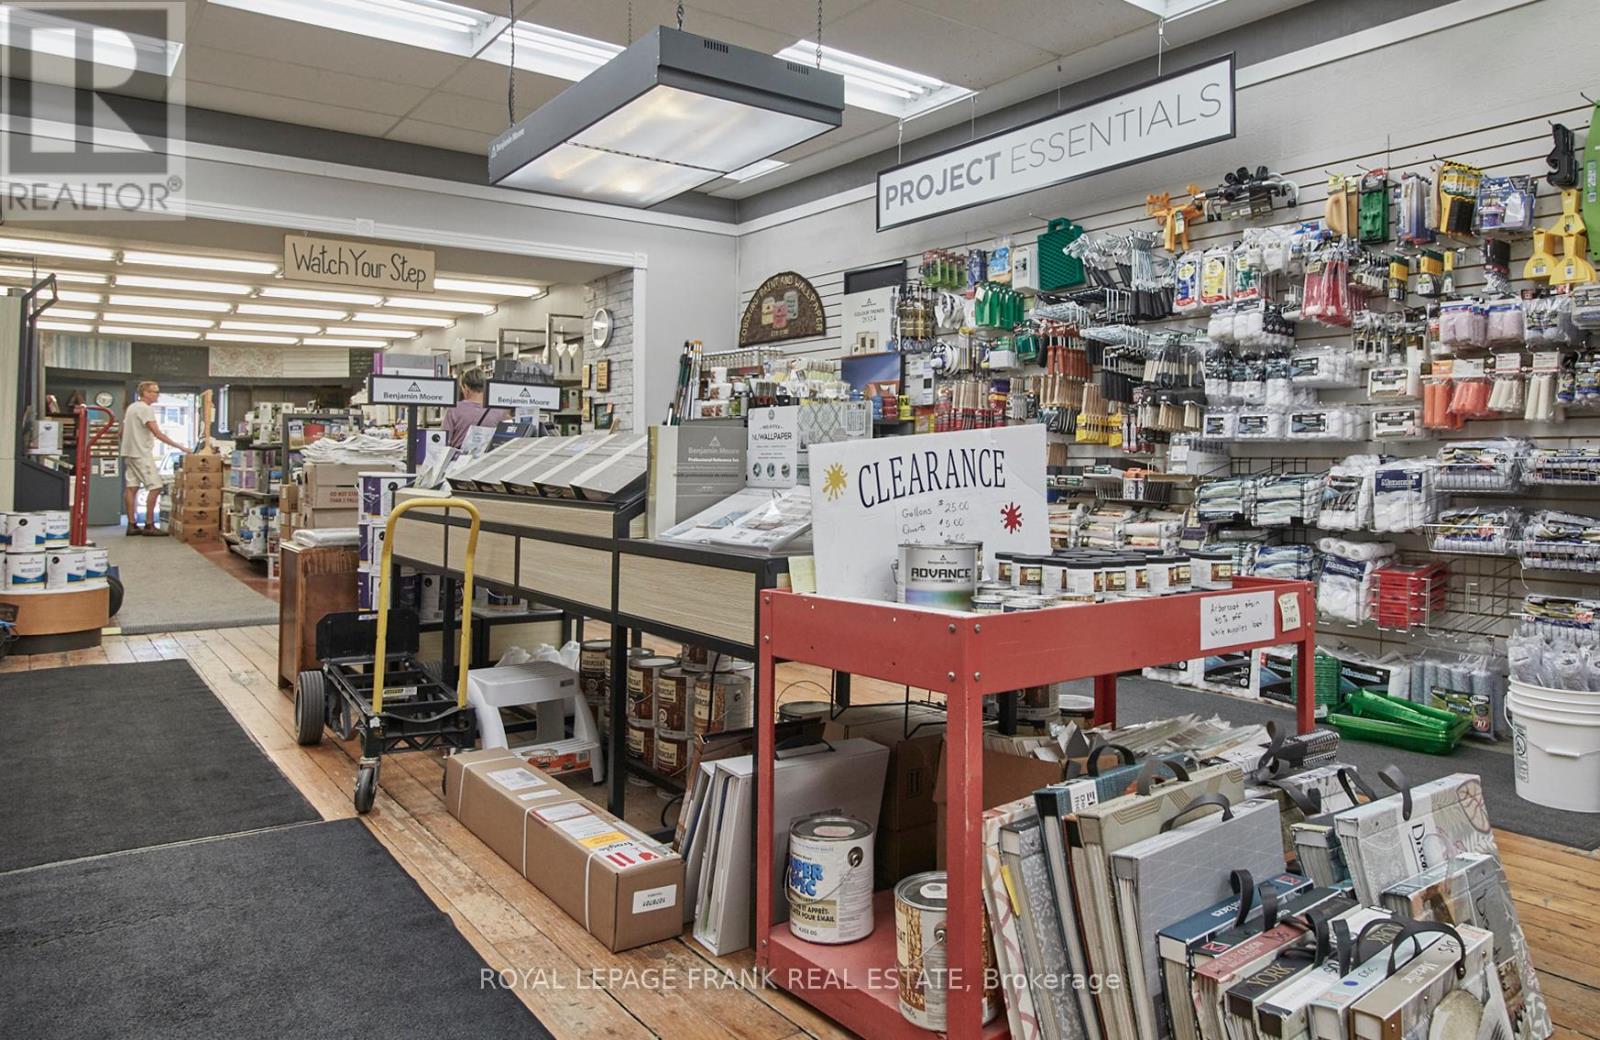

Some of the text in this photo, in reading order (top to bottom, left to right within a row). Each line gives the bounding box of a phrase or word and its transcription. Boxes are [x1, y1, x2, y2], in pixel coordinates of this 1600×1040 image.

[885, 82, 1222, 210] PROJECT ESSENTIALS
[292, 242, 427, 291] Watch Your Step
[383, 391, 443, 401] Benjamin Moore
[497, 396, 551, 406] Benjamin Moore
[858, 449, 1006, 509] CLEARANCE
[901, 505, 932, 518] Gallons
[911, 567, 972, 579] ADVANCE
[1247, 963, 1297, 988] YORK
